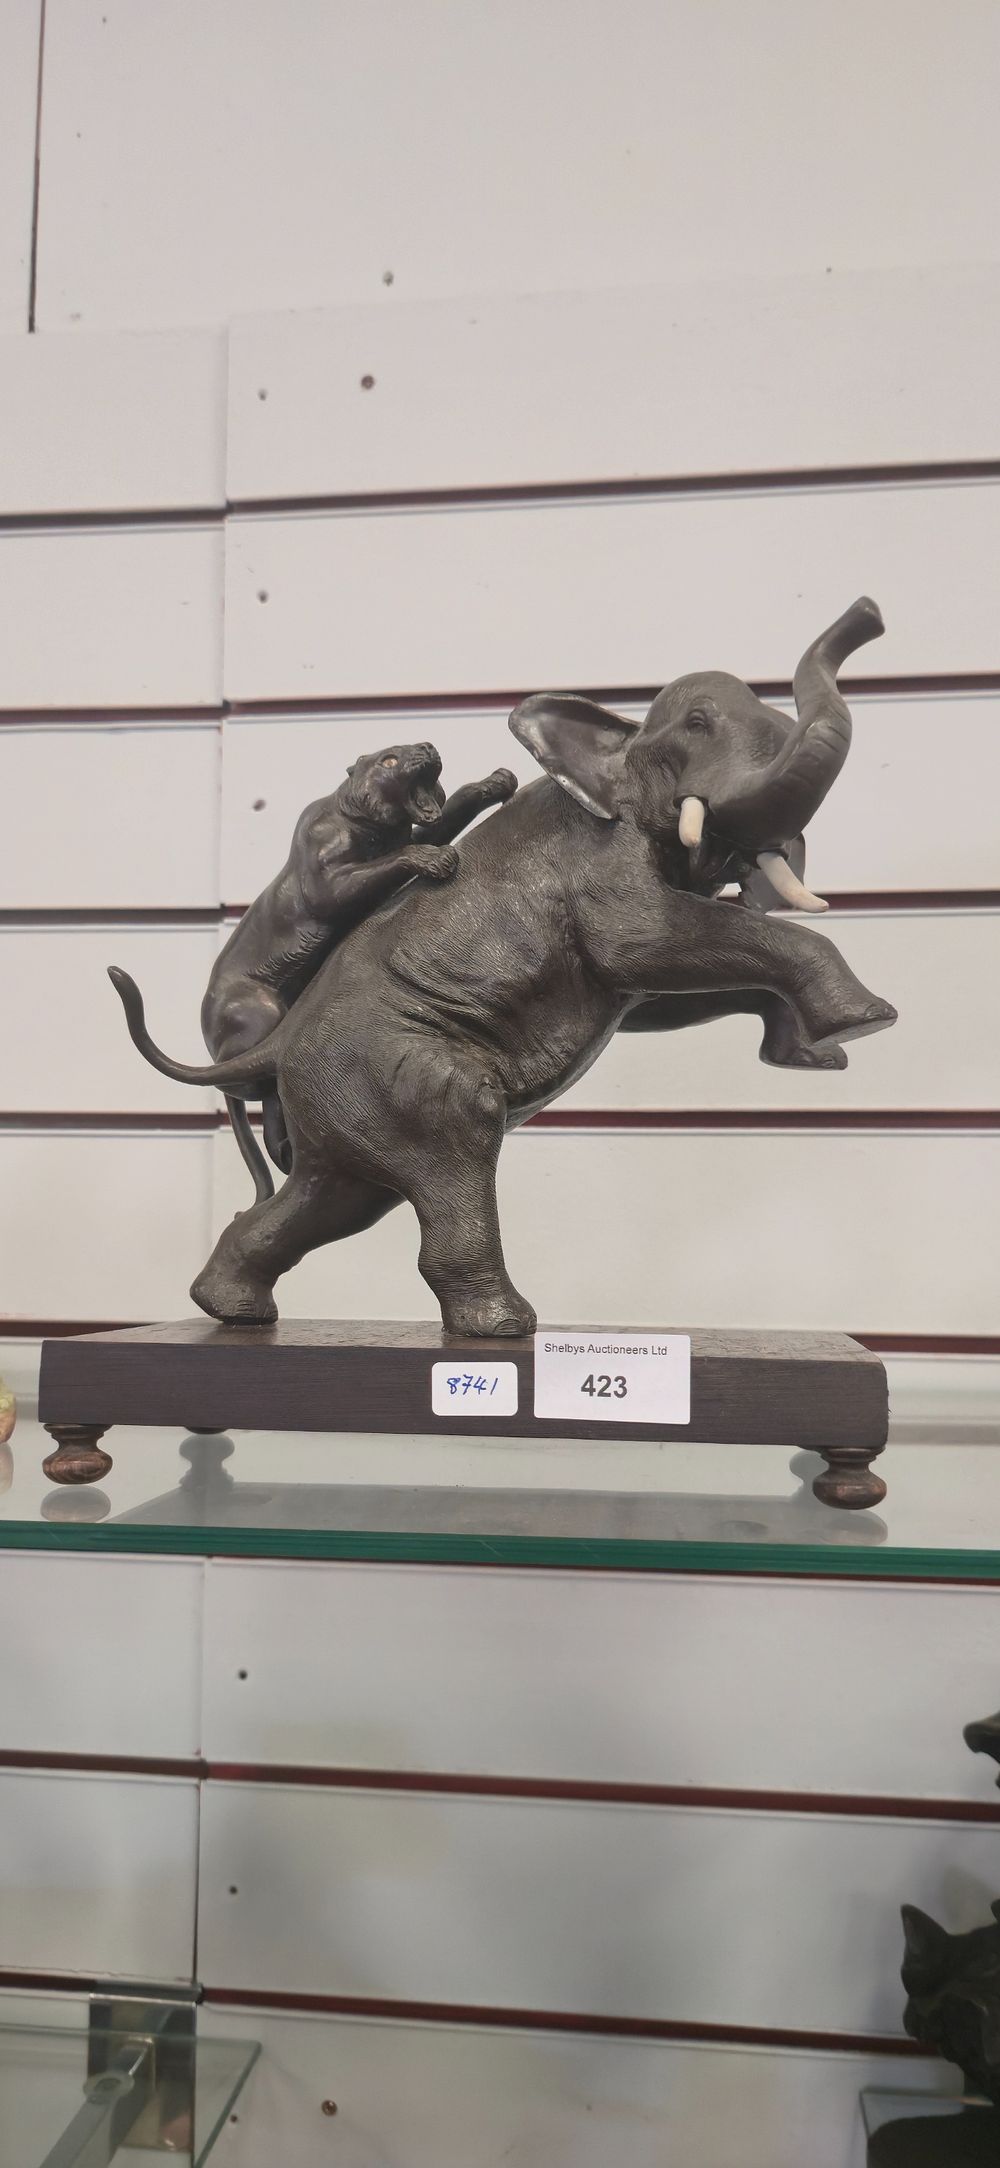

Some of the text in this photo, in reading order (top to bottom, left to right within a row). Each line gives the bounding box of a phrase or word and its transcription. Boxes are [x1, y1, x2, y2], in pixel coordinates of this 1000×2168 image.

[544, 1343, 668, 1356] Shelbys Auctioneers Ltd
[446, 1374, 499, 1395] 8741
[580, 1374, 628, 1399] 423
